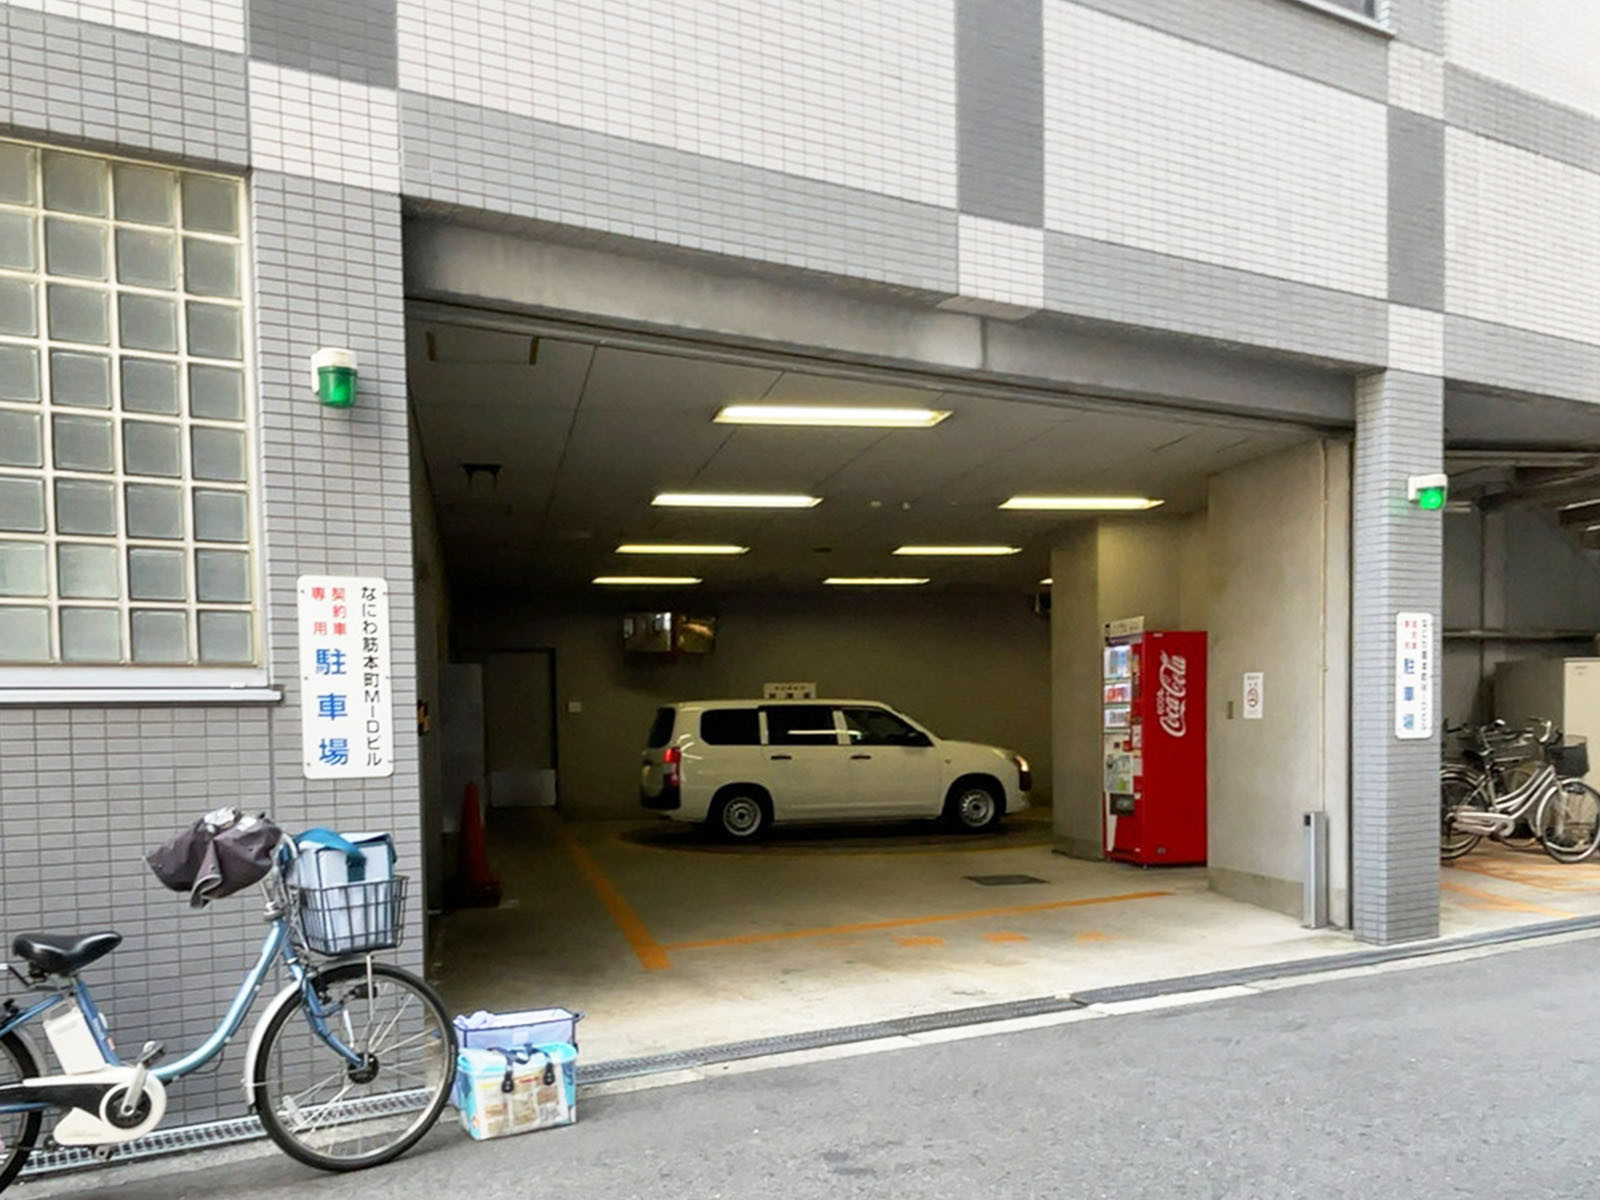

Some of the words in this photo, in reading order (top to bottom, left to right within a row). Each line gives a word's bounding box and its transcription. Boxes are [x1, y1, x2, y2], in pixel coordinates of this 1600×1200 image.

[331, 587, 347, 636] 契約車
[315, 648, 349, 766] 駐車場
